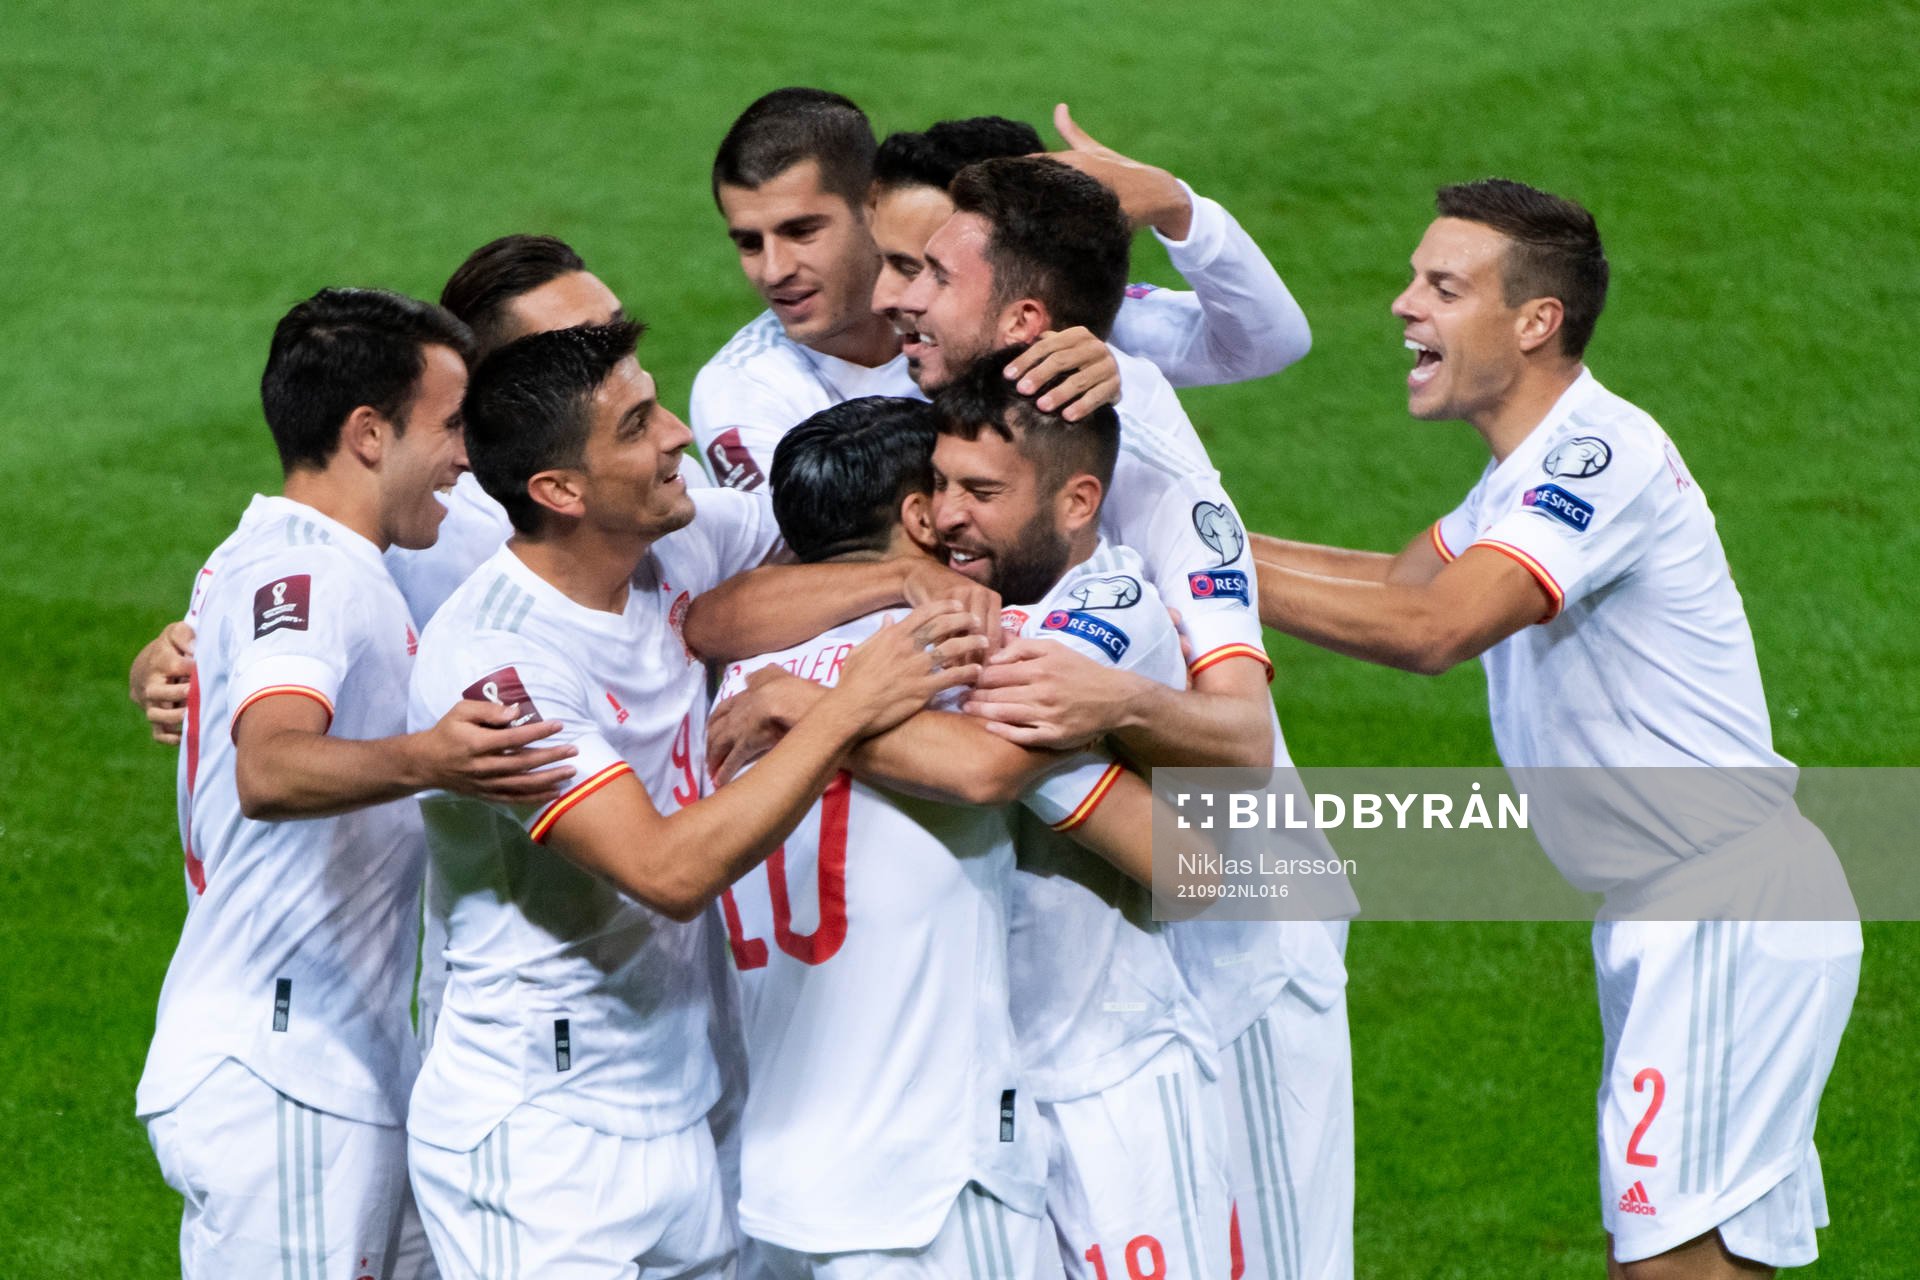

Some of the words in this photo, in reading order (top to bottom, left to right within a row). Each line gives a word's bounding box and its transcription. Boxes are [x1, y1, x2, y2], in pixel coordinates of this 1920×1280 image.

[1536, 489, 1592, 525] RESPECT
[1215, 577, 1243, 592] RES
[1068, 617, 1128, 656] RESPECT
[671, 711, 699, 808] 9
[1626, 1067, 1666, 1168] 2
[1618, 1200, 1657, 1217] adidas
